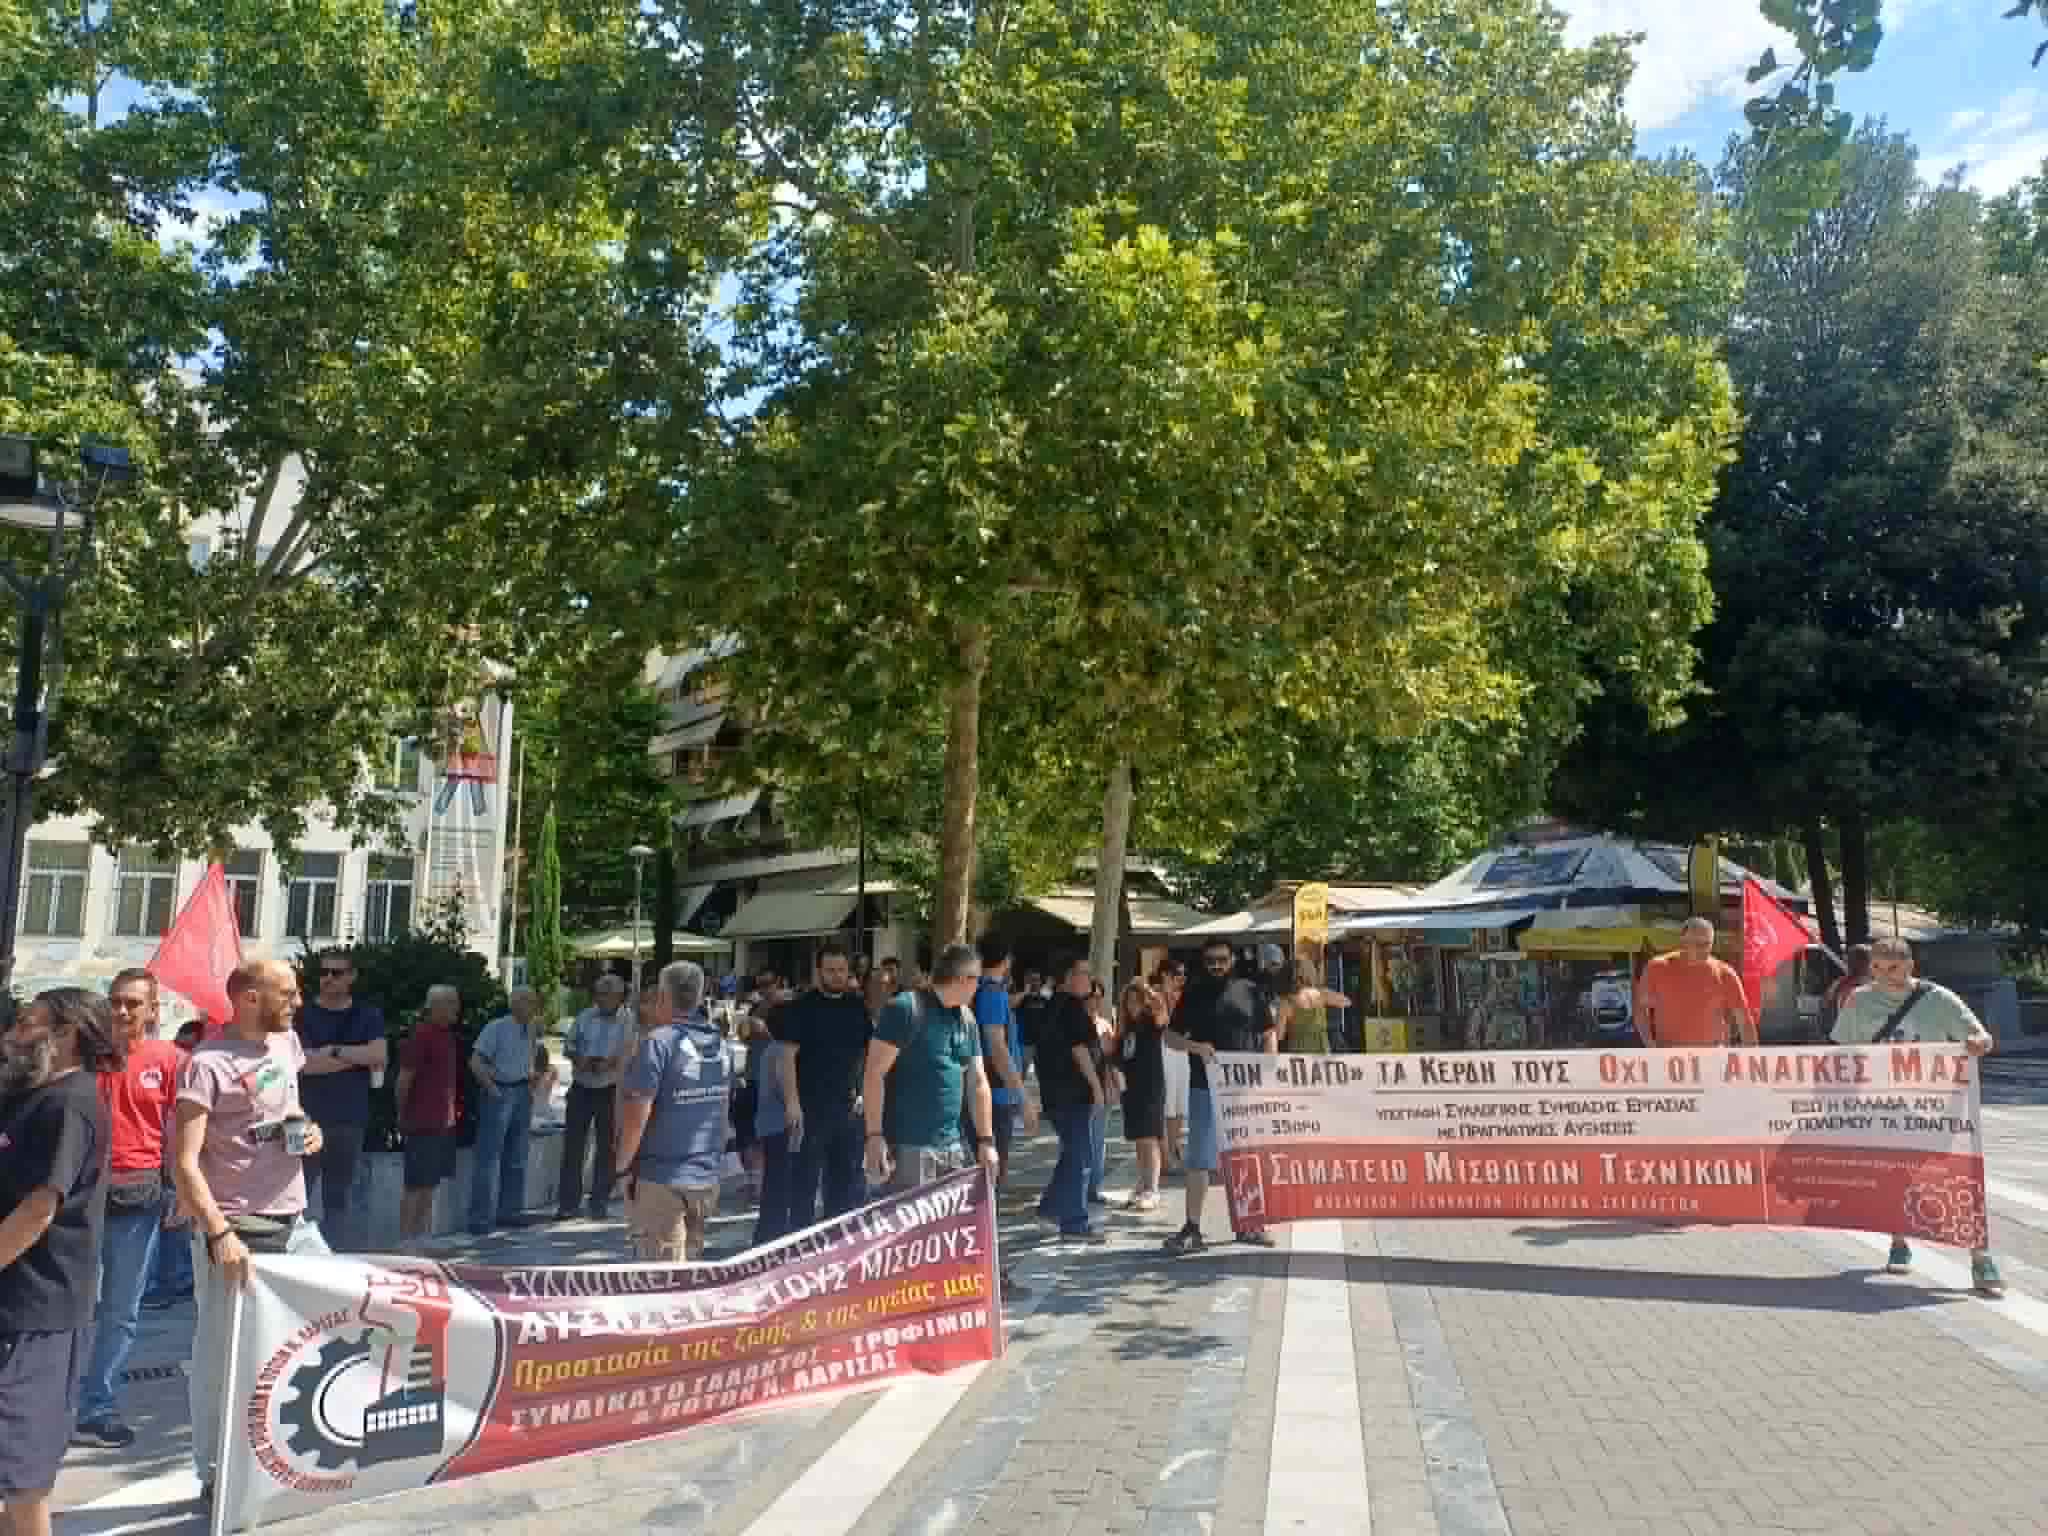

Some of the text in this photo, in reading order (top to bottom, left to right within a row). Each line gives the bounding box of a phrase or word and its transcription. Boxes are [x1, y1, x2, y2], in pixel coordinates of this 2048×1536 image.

[1220, 1062, 1262, 1086] ΤΟΝ
[1376, 1061, 1406, 1084] ΤΑ
[1419, 1057, 1496, 1085] ΚΕΡΔΗ
[1512, 1060, 1570, 1084] ΤΟΥΣ
[1600, 1055, 1648, 1083] ΟΧΙ
[1724, 1053, 1872, 1083] ΑΝΑΓΚΕΣ
[1889, 1047, 1970, 1083] ΜΑΣ
[1626, 1098, 1698, 1113] ΕΡΓΑΣΙΑΣ
[1270, 1151, 1409, 1185] ΣΩΜΑΤΕΙΟ
[1423, 1151, 1584, 1185] ΜΙΣΘΩΤΩΝ
[1600, 1152, 1753, 1185] ΤΕΧΝΙΚΩΝ
[859, 1225, 982, 1283] ΜΙΣΘΟΥΣ
[513, 1338, 672, 1392] Προστασία
[680, 1333, 724, 1361] της
[734, 1317, 793, 1353] ζωής
[865, 1278, 937, 1314] υγείας
[943, 1272, 985, 1298] μας
[510, 1381, 686, 1433] ΣΥΝΔΙΚΑΤΟ
[852, 1310, 987, 1353] ΤΡΟΦΙΜΩΝ
[793, 1351, 898, 1391] ΛΑΡΙΣΑΣ
